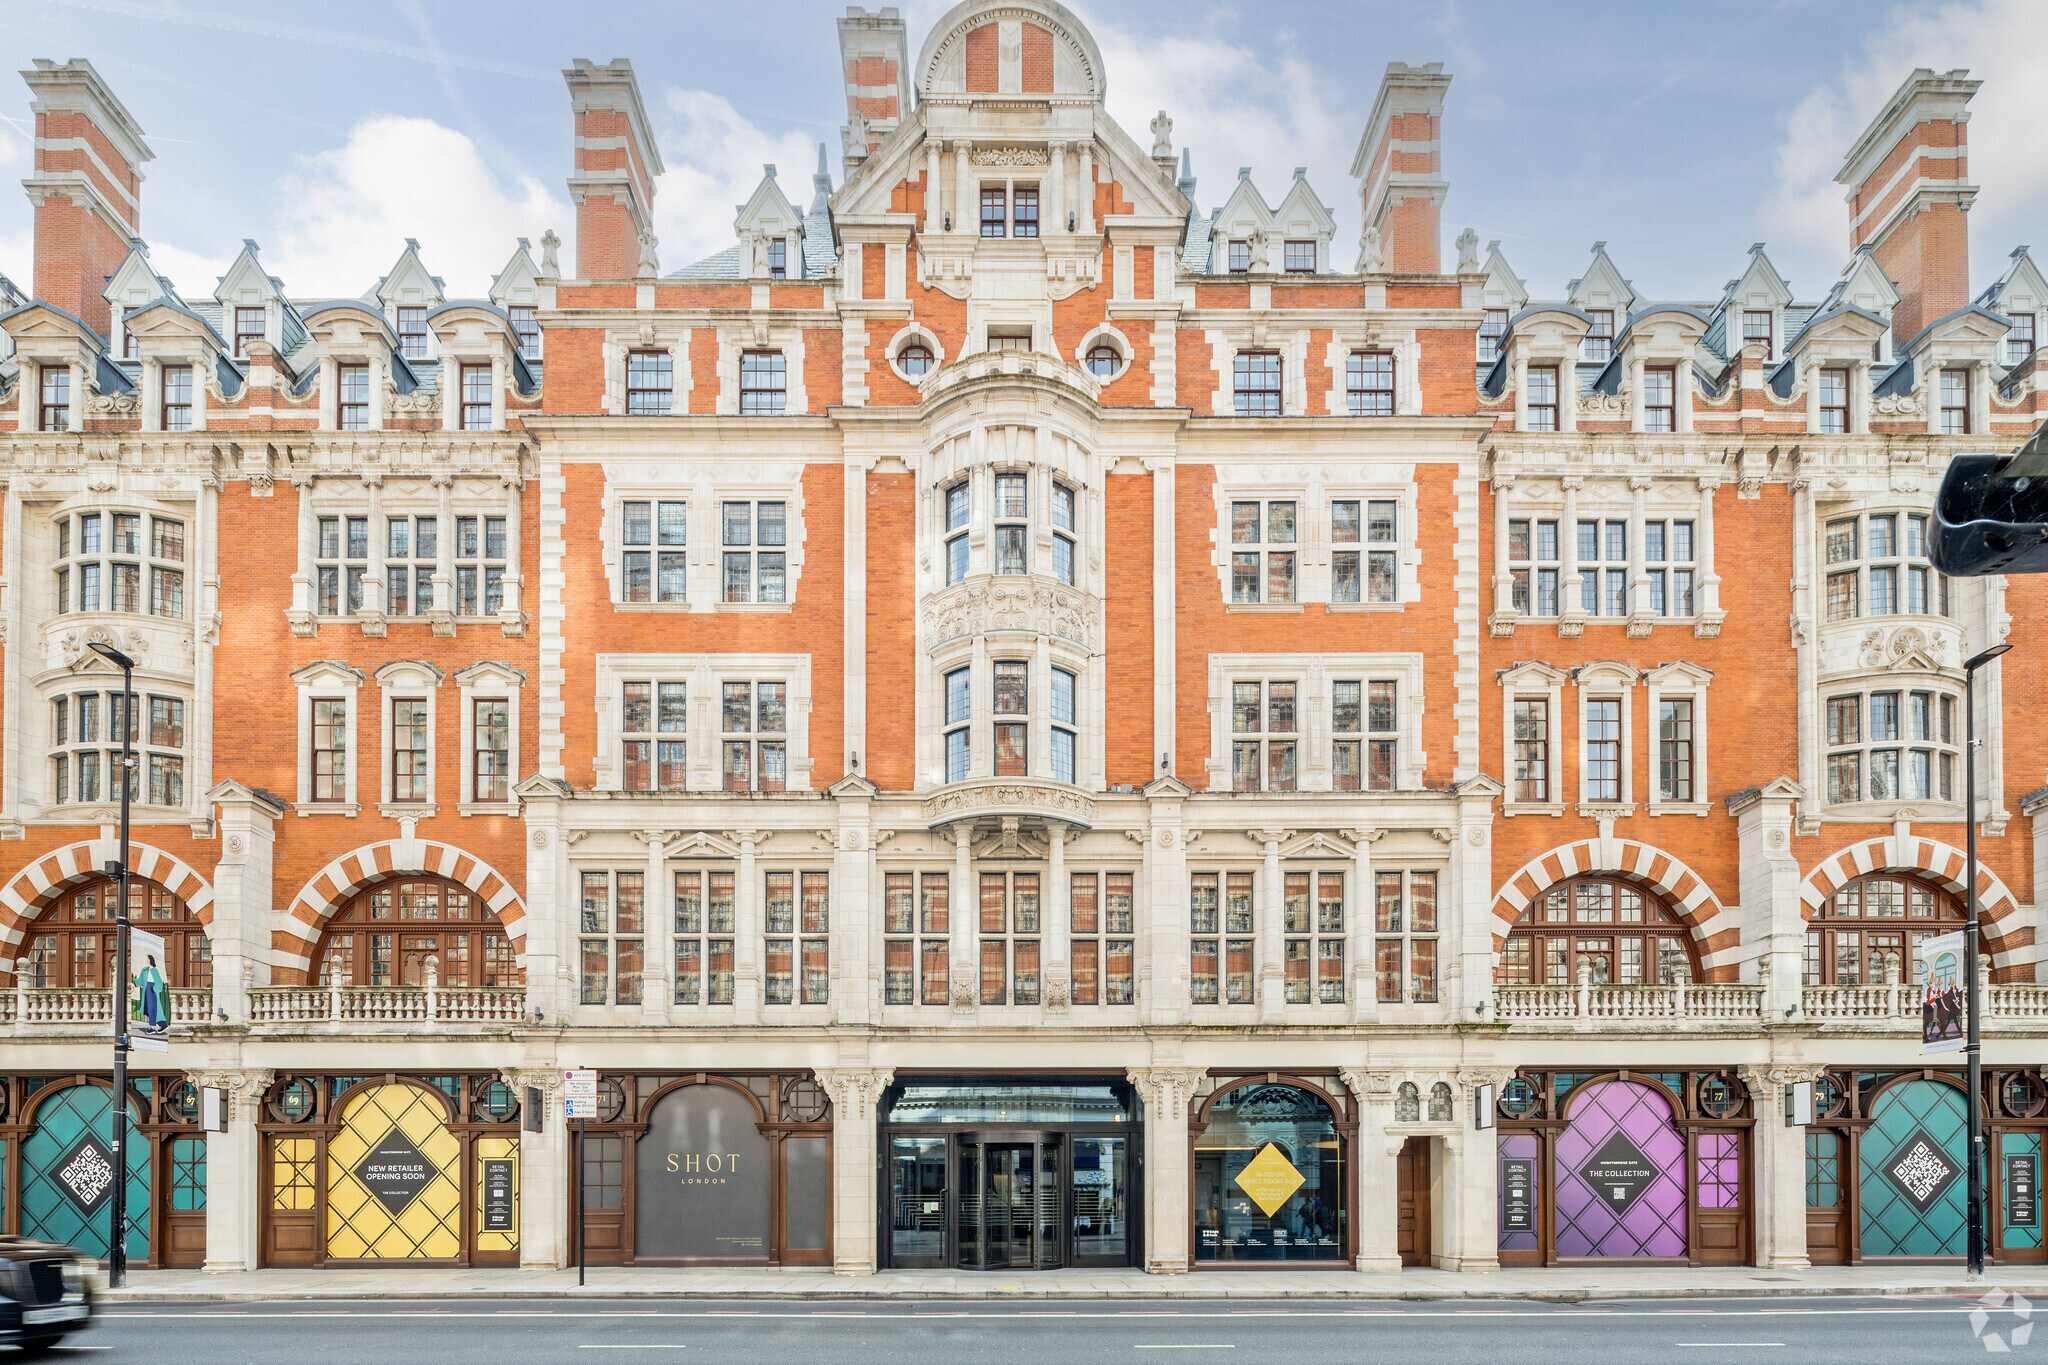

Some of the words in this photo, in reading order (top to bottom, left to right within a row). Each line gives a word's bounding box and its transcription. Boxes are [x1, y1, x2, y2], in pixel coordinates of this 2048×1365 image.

[186, 1095, 196, 1106] 67
[288, 1095, 299, 1105] 69
[597, 1094, 606, 1104] 71
[1714, 1092, 1723, 1101] 77
[1815, 1092, 1825, 1101] 79
[666, 1153, 740, 1173] SHOT
